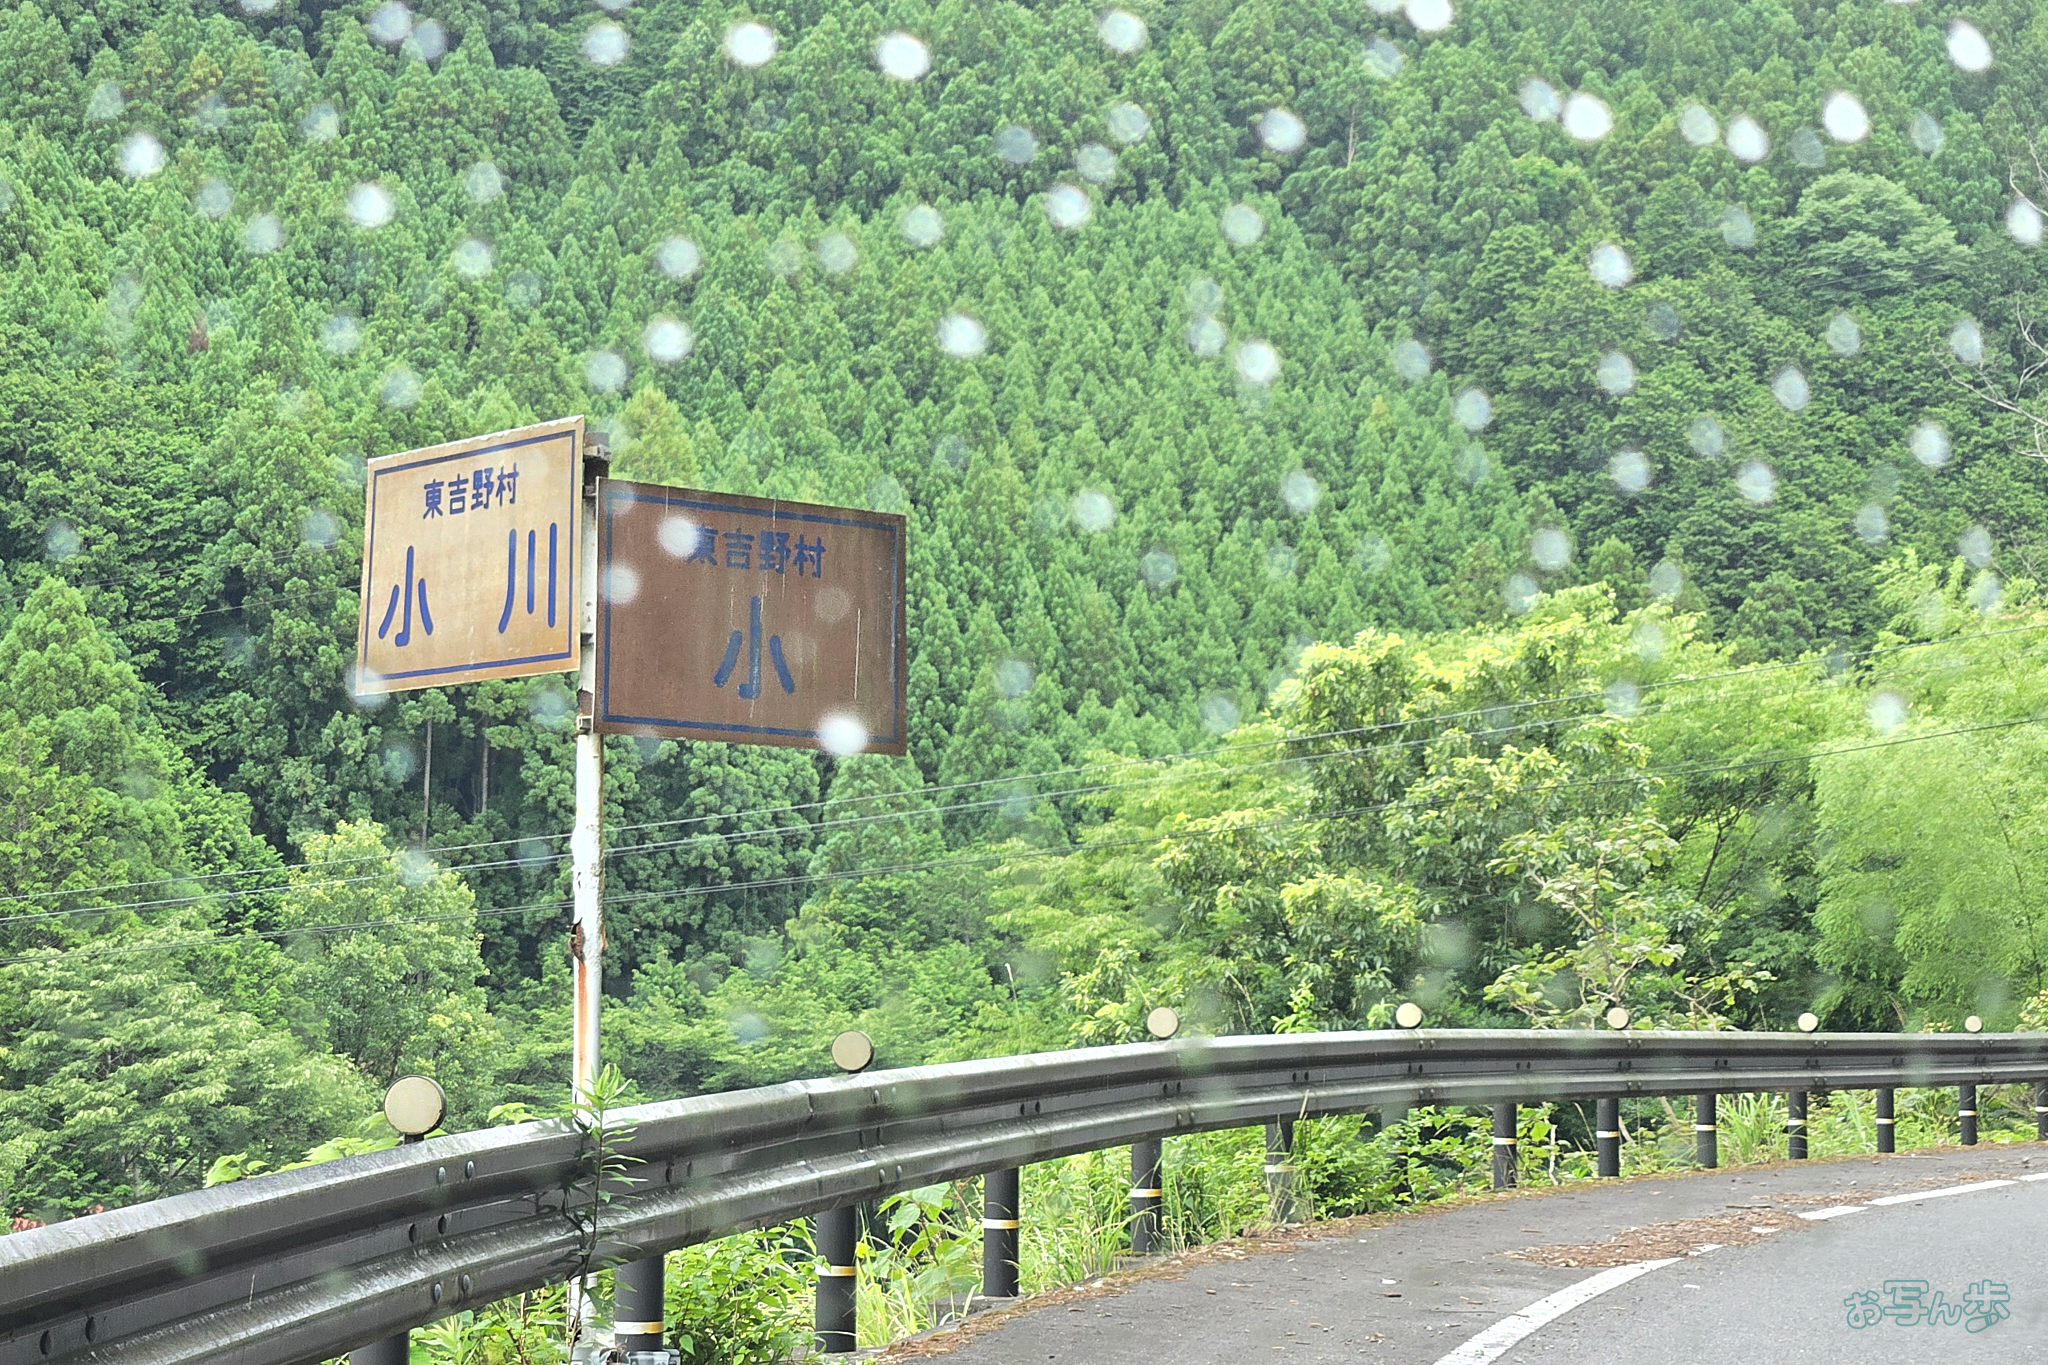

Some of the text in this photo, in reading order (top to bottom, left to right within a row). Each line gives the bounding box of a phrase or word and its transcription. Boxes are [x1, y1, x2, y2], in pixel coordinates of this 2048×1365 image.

[423, 462, 519, 519] 東吉野村
[713, 595, 796, 700] 小
